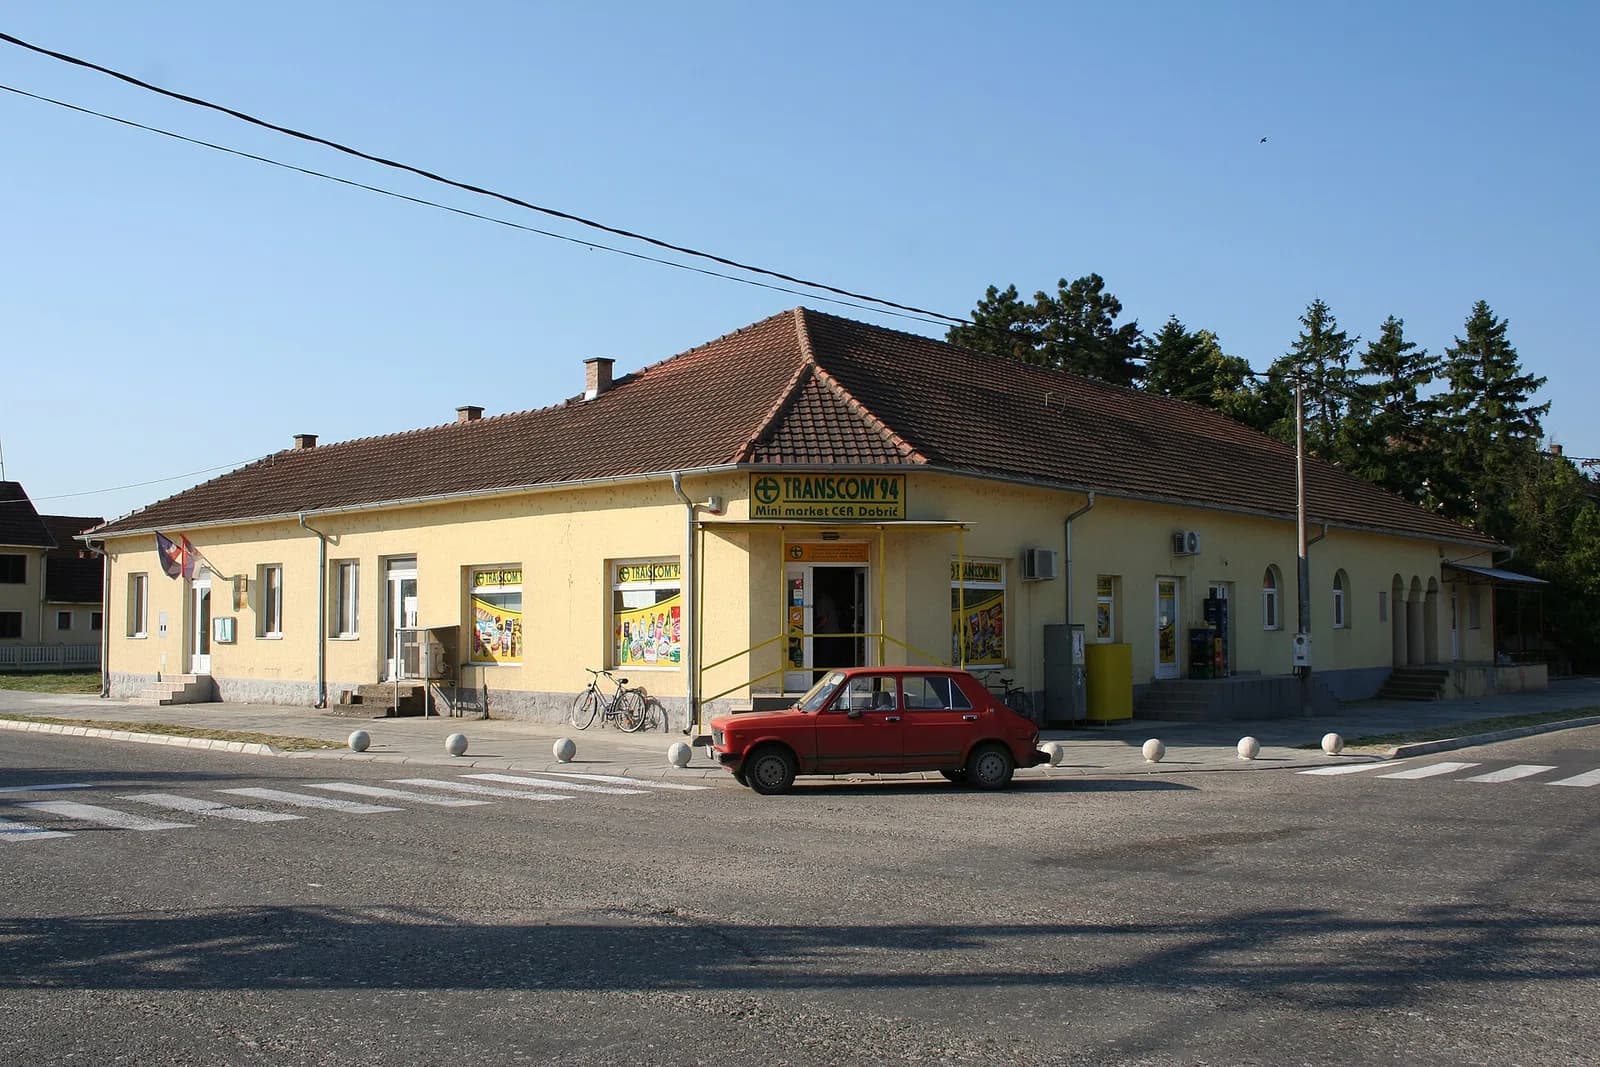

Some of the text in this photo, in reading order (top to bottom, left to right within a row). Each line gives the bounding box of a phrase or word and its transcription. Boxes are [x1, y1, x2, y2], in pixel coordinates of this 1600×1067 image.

[783, 477, 899, 500] TRANSCOM'94
[755, 506, 781, 517] Mini
[785, 506, 829, 517] market
